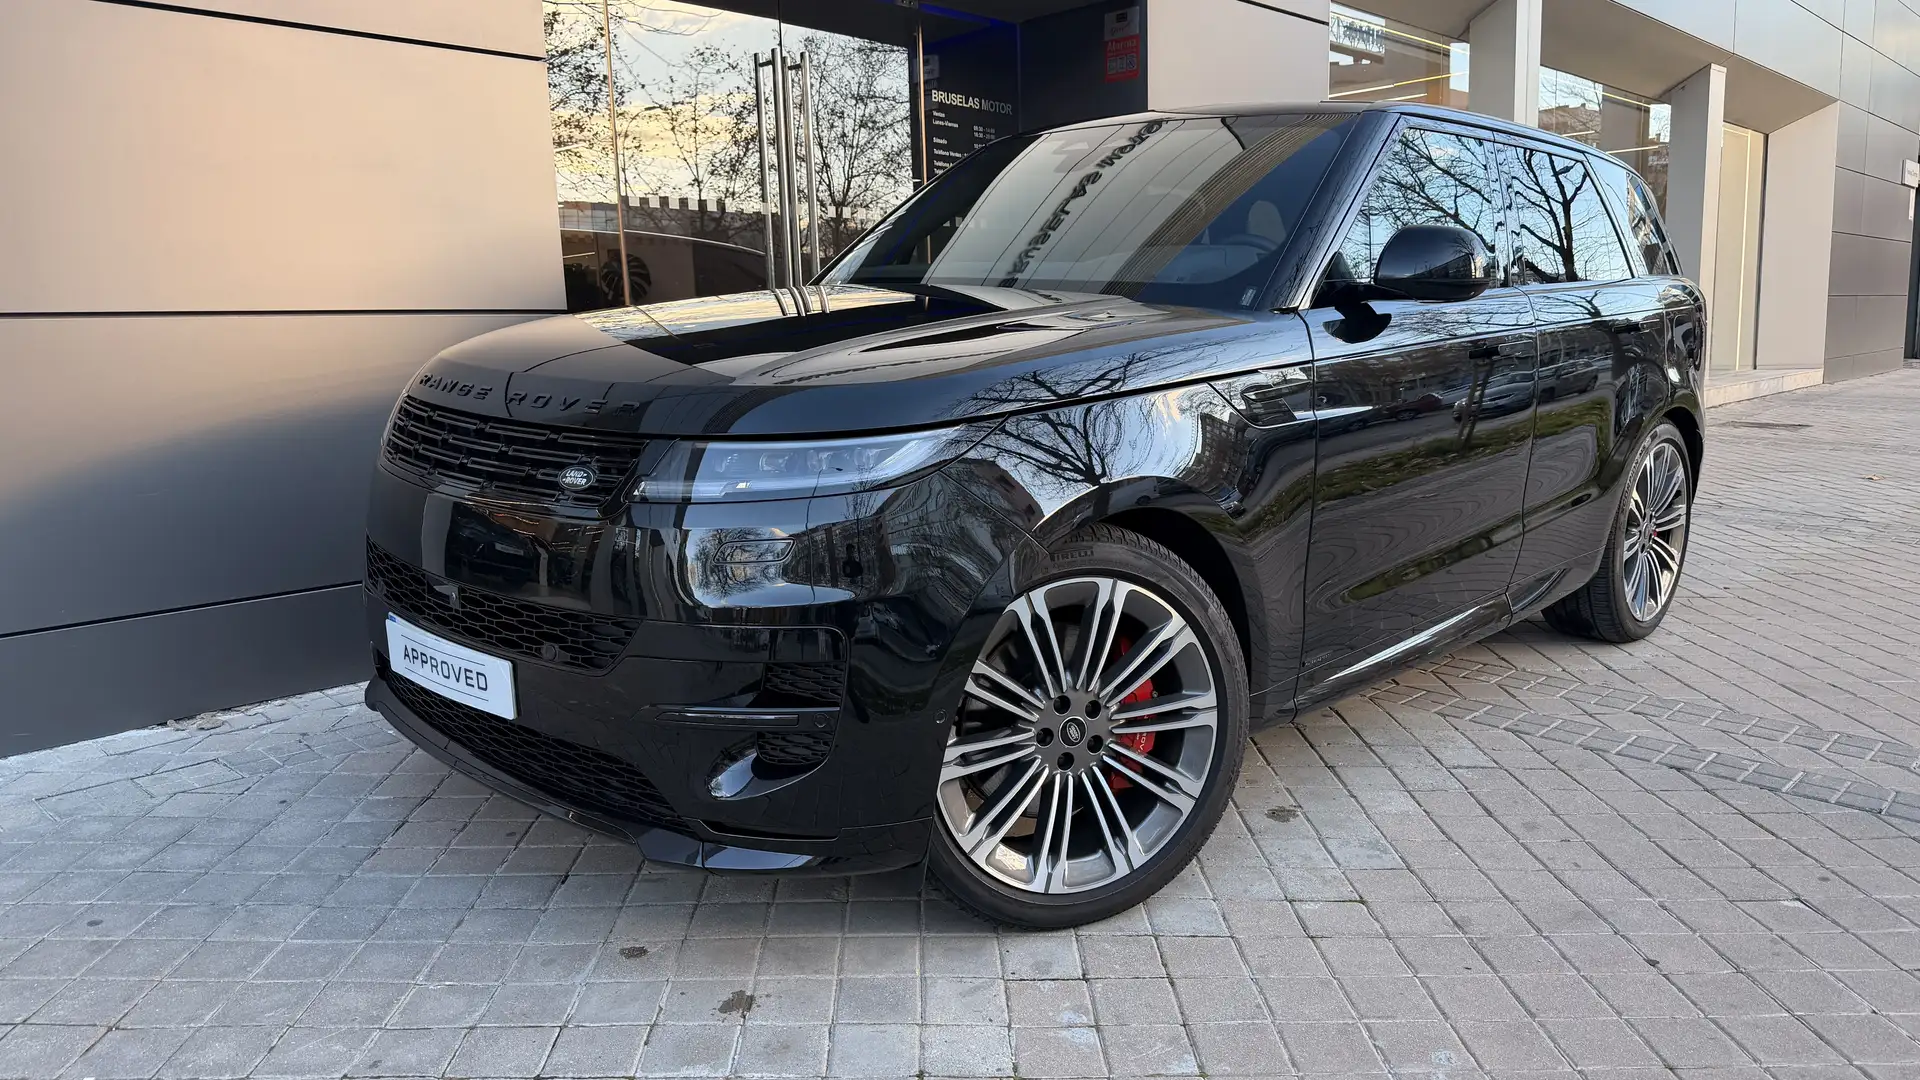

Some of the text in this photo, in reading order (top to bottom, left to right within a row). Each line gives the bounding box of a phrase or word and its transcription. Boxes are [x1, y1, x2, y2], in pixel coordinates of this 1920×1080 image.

[931, 89, 1013, 115] BRUSELAS MOTOR
[418, 373, 640, 416] RANGE ROVER
[564, 476, 587, 486] ROVER
[565, 470, 584, 478] LAND
[403, 644, 488, 691] APPROVED
